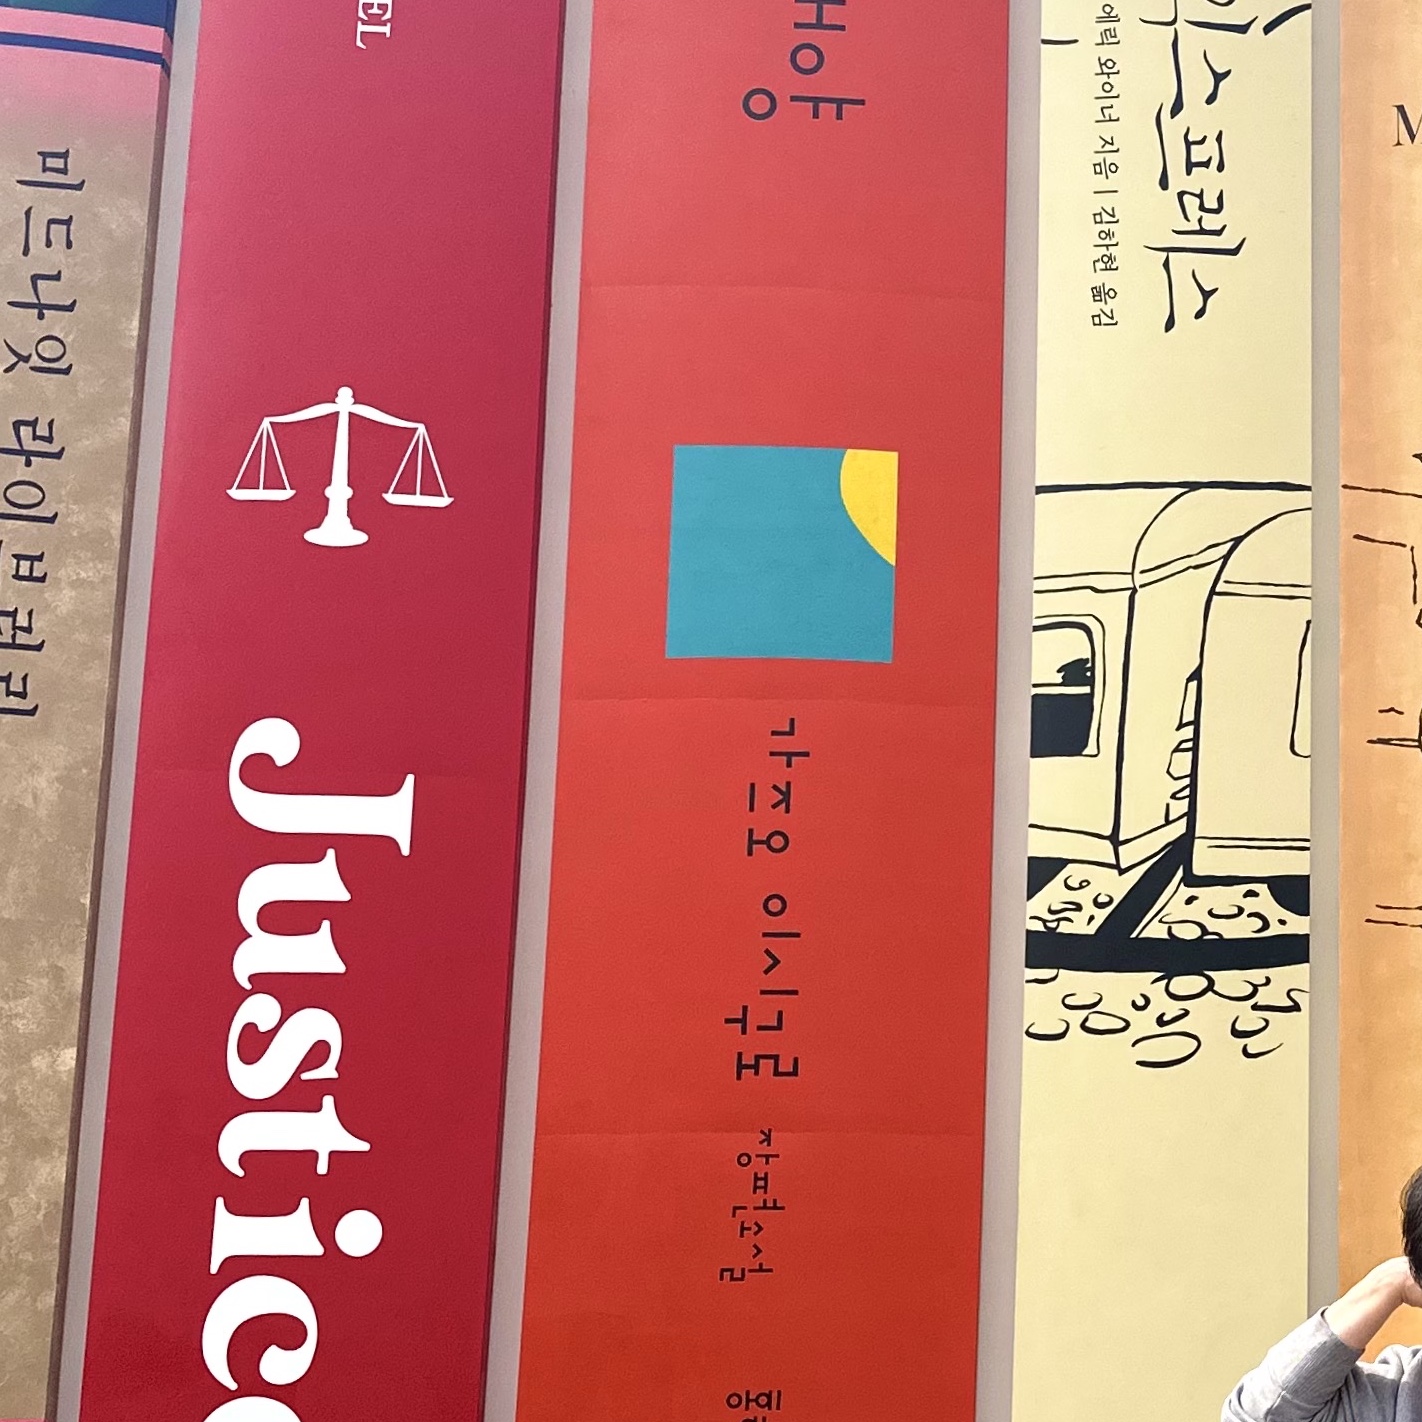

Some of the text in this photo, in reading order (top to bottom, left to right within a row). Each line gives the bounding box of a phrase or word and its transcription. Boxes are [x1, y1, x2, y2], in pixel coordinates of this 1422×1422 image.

[3, 149, 85, 375] 미드나잇
[1091, 4, 1120, 326] 에릭 와이너 지음 김하현 옮김
[724, 718, 810, 1080] 가즈오 이시구로
[720, 1128, 785, 1282] 장편소설
